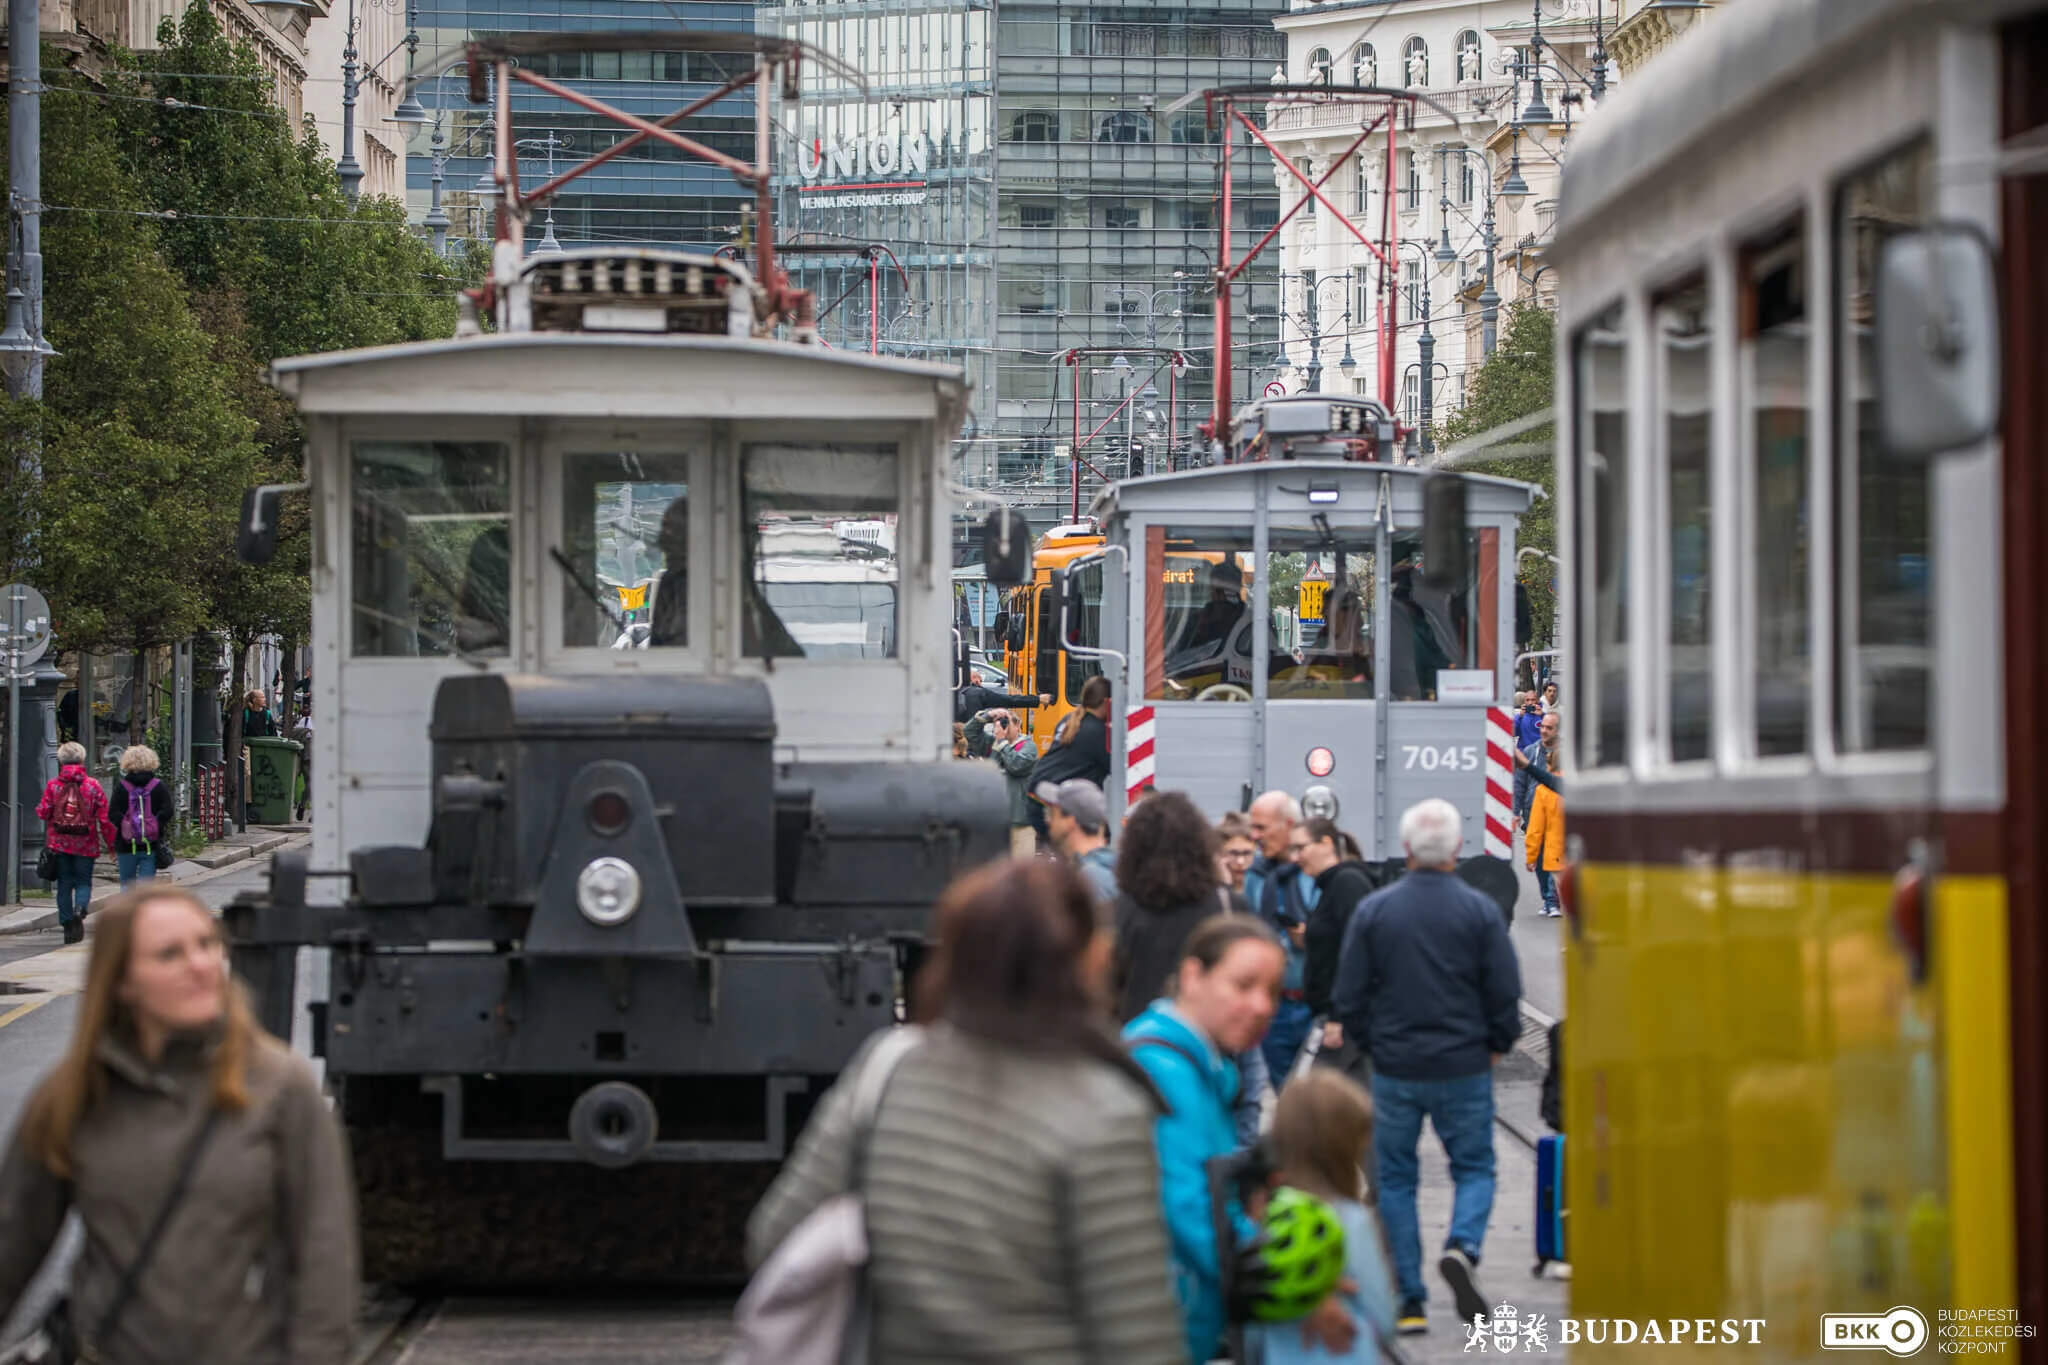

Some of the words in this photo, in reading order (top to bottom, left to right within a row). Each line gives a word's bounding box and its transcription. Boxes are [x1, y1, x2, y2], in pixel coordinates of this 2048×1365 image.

[798, 133, 927, 179] UNION
[800, 195, 837, 209] VIENNA
[837, 193, 891, 207] INSURANCE
[892, 191, 926, 206] GROUP
[1402, 745, 1479, 771] 7045
